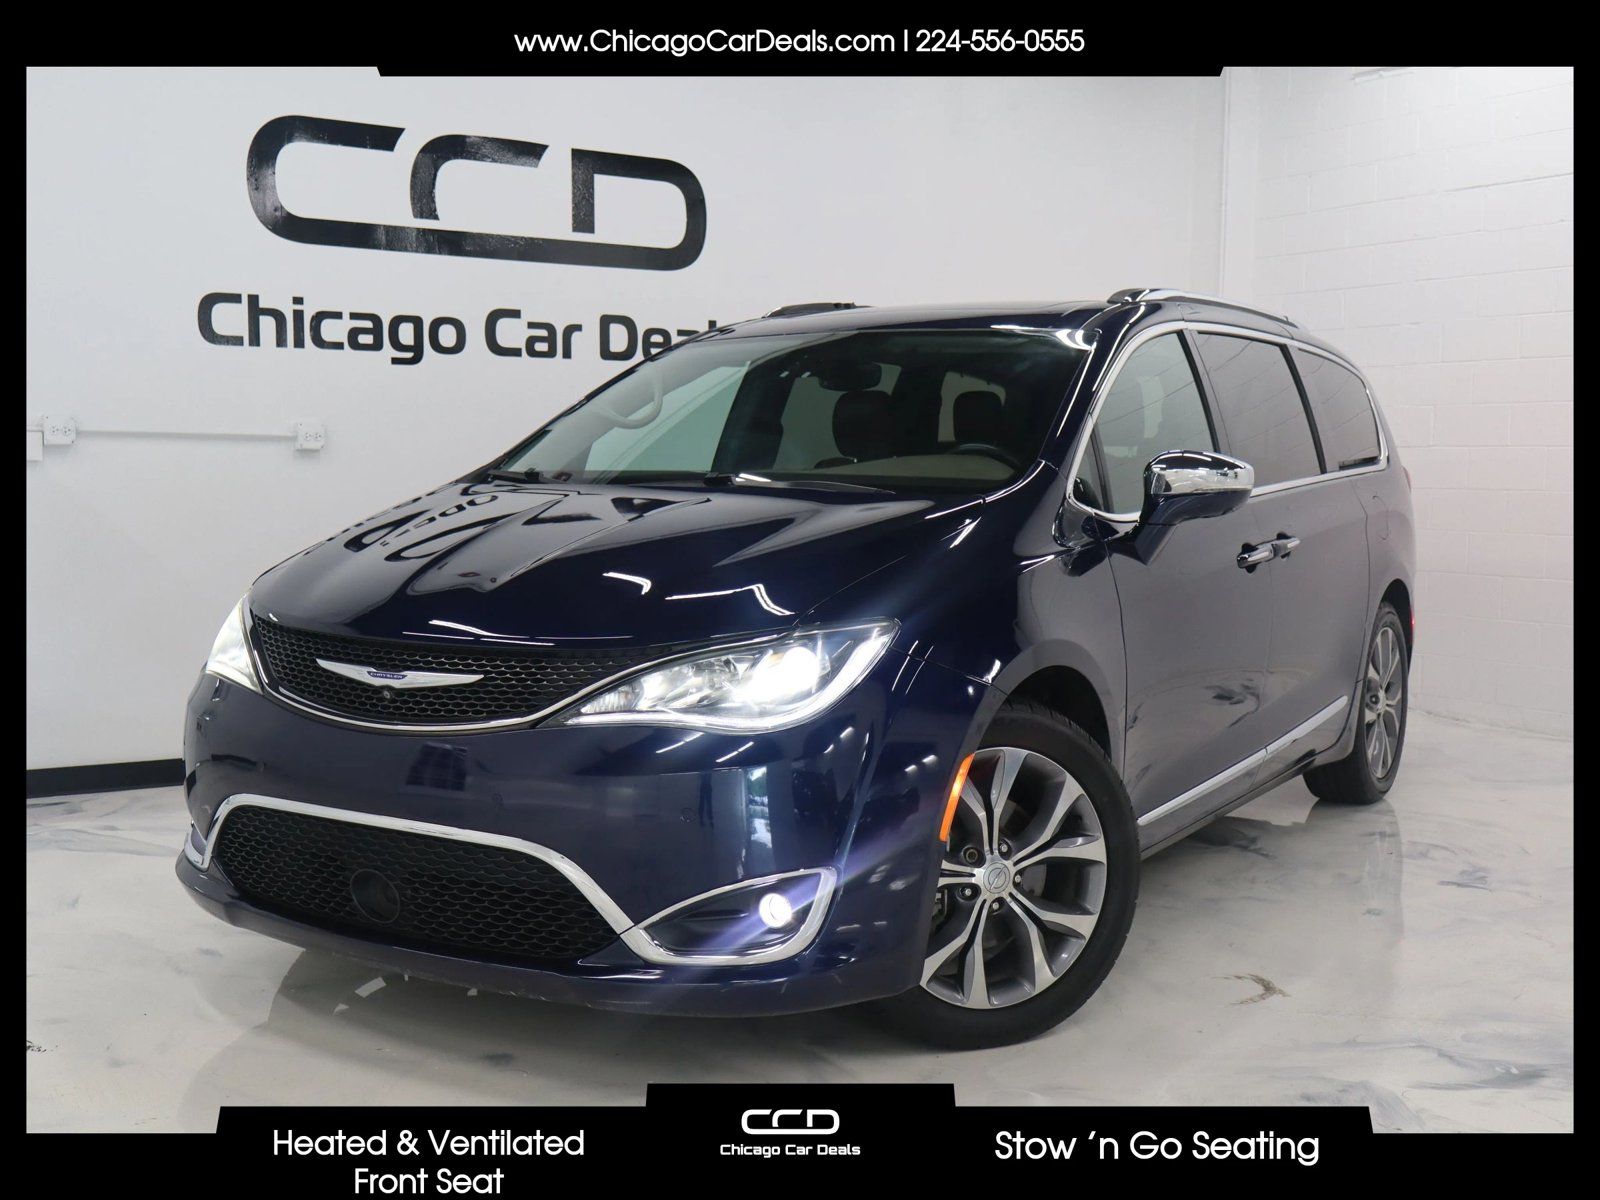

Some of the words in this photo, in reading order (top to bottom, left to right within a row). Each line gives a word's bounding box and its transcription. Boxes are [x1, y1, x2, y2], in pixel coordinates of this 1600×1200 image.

[246, 115, 707, 271] CCD
[197, 292, 467, 366] Chicago
[484, 308, 583, 360] Car
